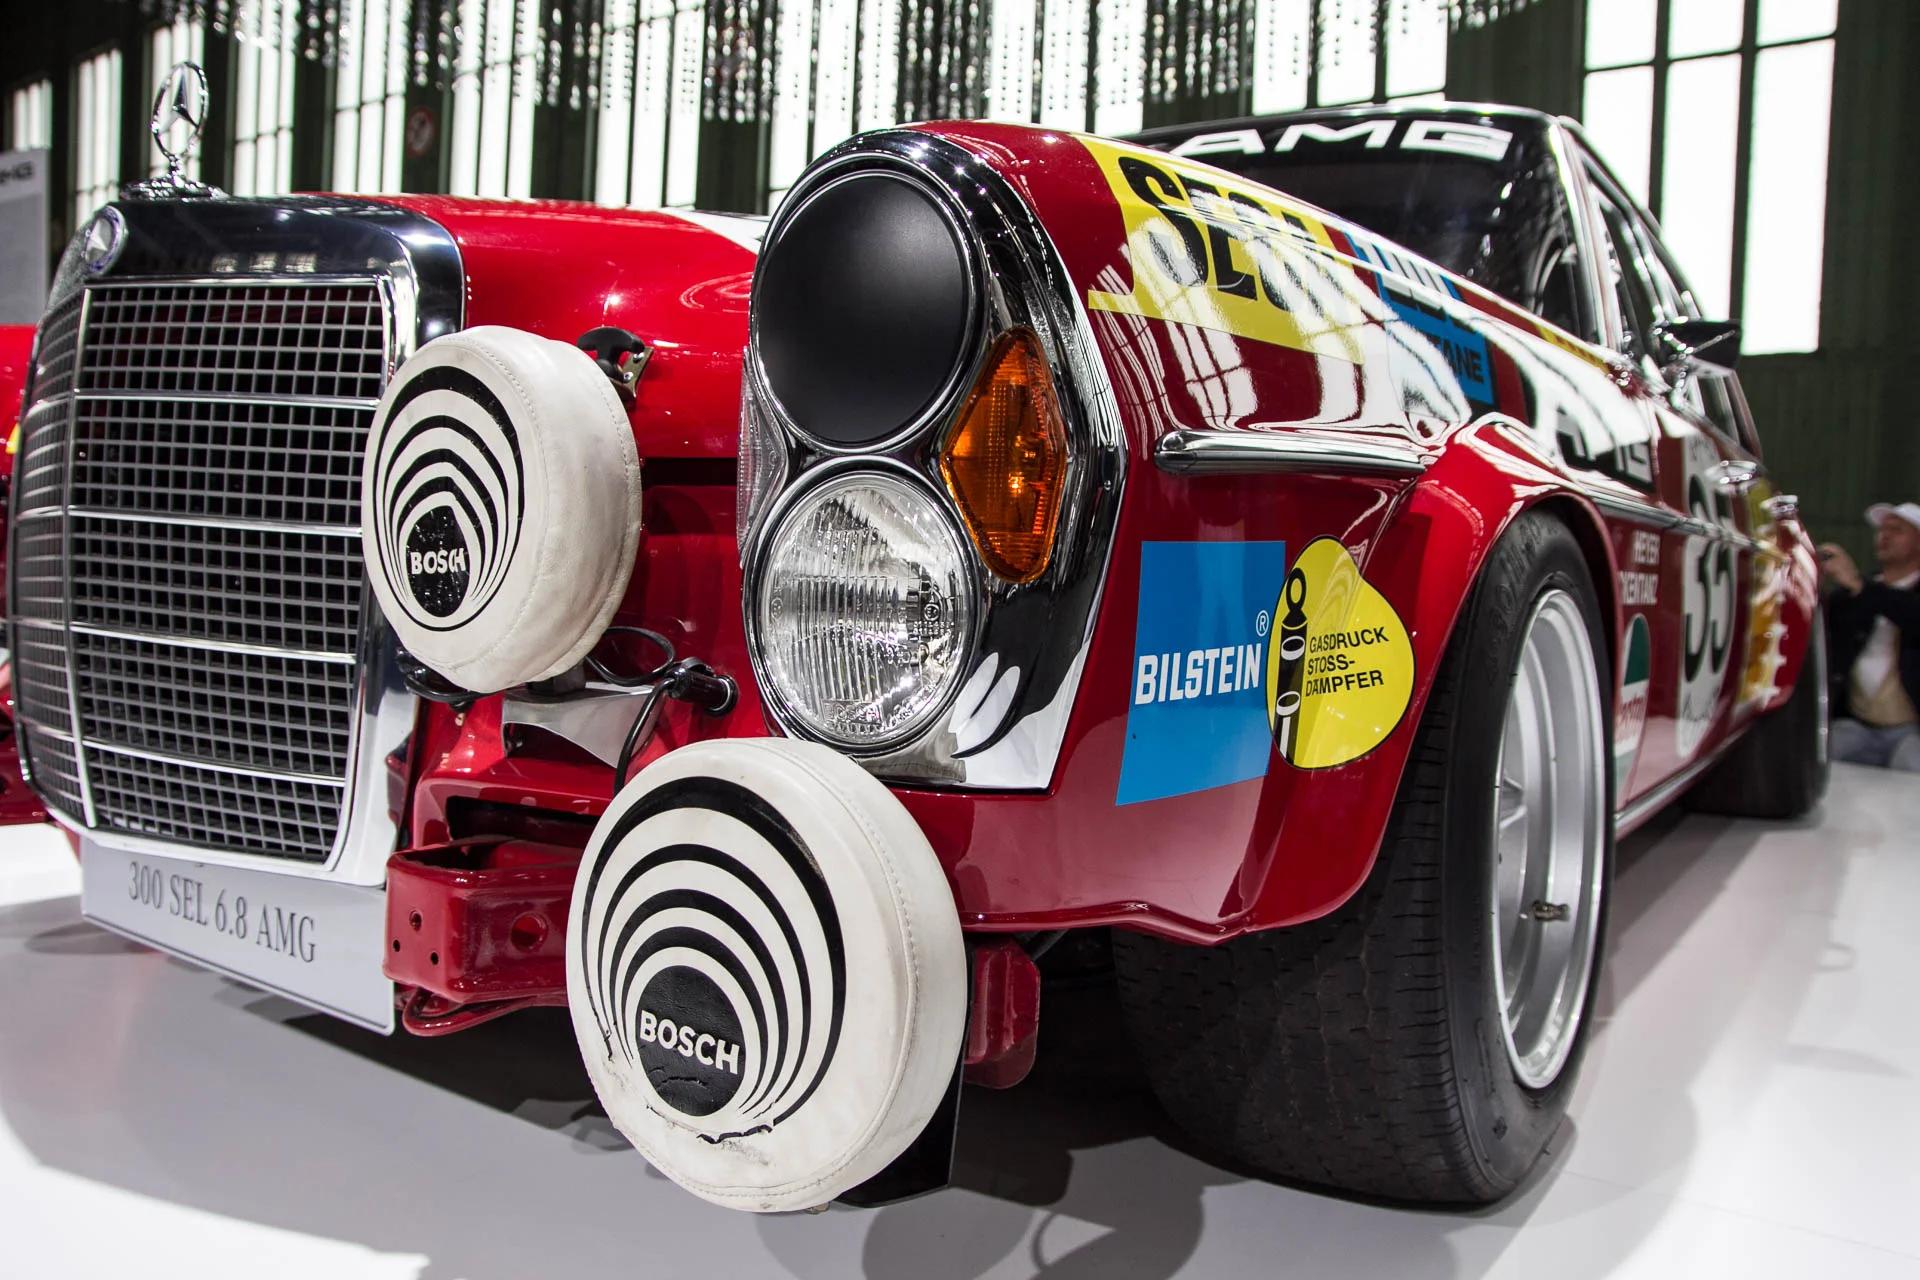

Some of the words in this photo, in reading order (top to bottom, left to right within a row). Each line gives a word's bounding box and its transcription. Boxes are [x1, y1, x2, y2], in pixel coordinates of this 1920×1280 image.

[1169, 120, 1513, 161] AMG
[410, 547, 467, 575] BOSCH
[1309, 626, 1389, 654] GASDRUCK
[1135, 643, 1262, 705] BILSTEIN
[1307, 653, 1355, 676] STOSS-
[128, 861, 164, 909] 300
[169, 873, 208, 926] SEL
[215, 888, 248, 939] 6.8
[256, 904, 317, 963] AMG
[639, 1009, 740, 1075] BOSCH
